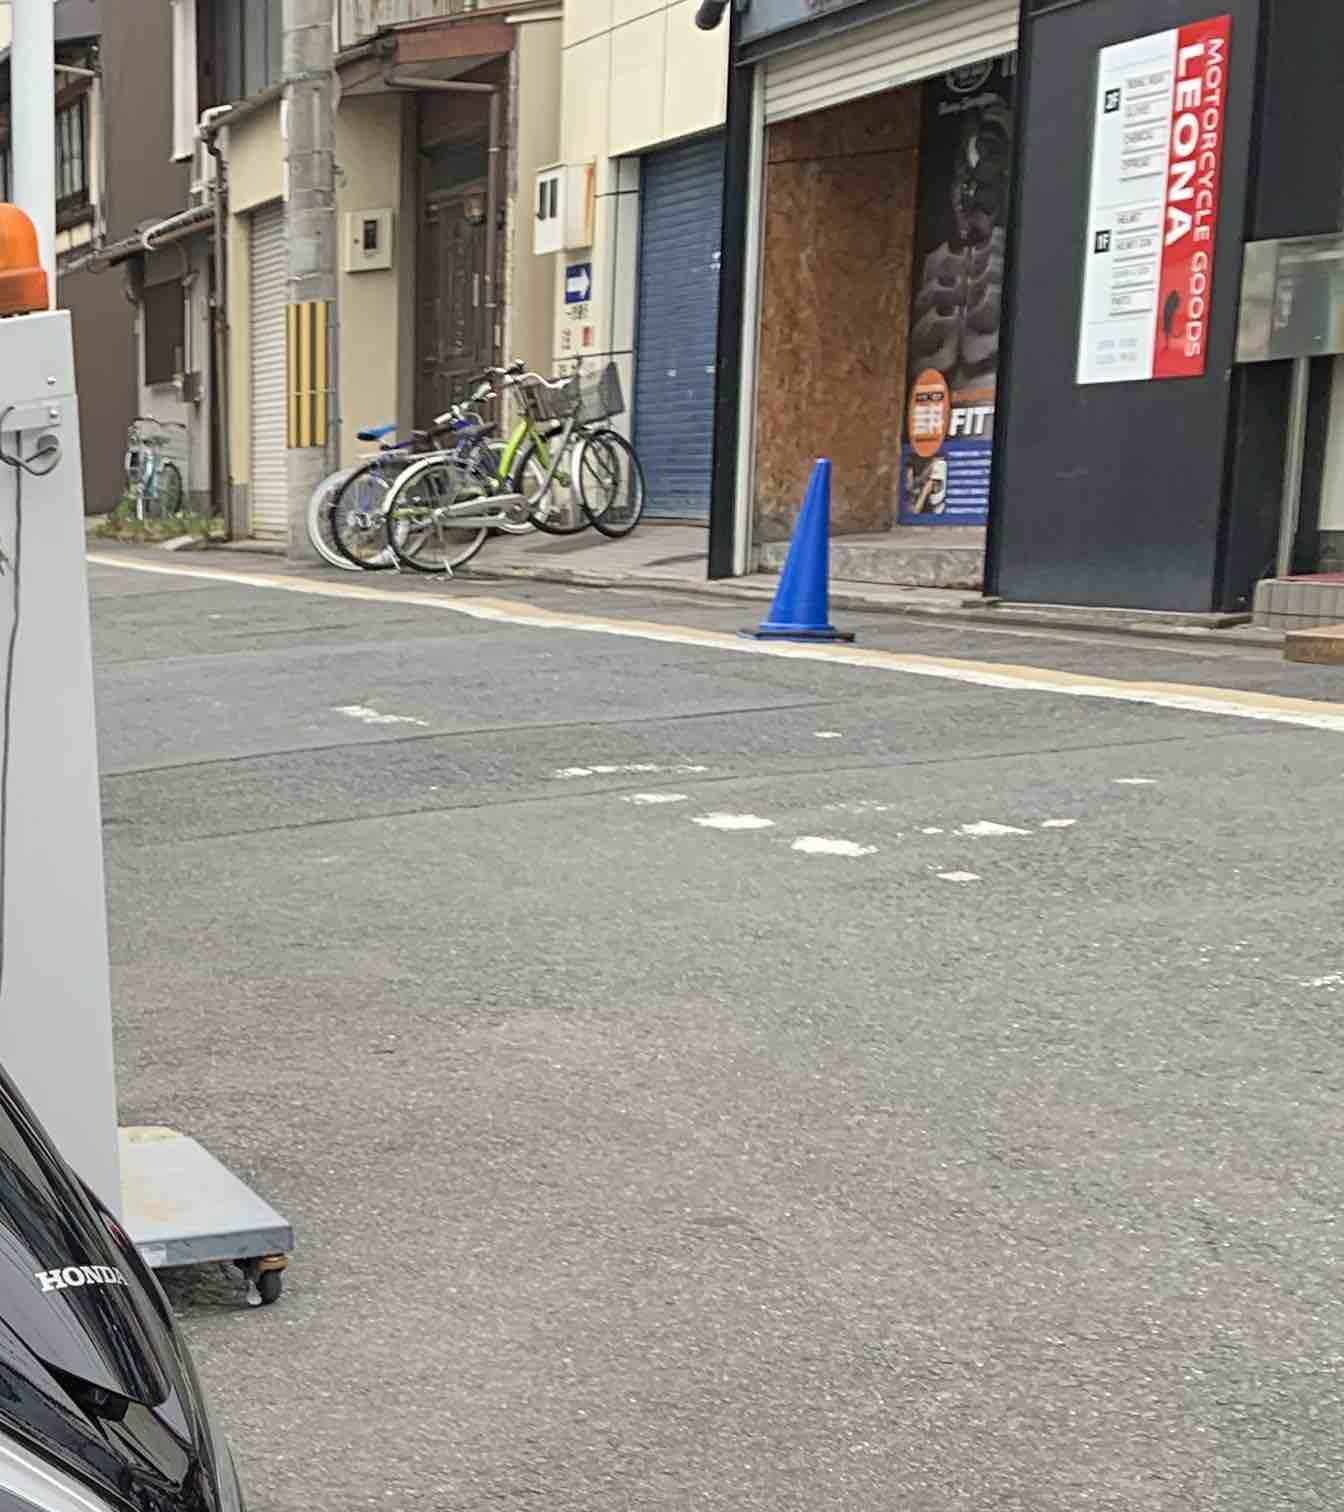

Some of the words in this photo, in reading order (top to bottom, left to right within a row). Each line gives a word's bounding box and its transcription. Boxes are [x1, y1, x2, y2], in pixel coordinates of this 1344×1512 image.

[1164, 42, 1205, 248] LEONA
[1192, 36, 1225, 242] MOTORCYCLE
[1183, 250, 1211, 359] GOODS
[949, 406, 995, 436] FIT
[35, 1265, 128, 1292] HONDA
